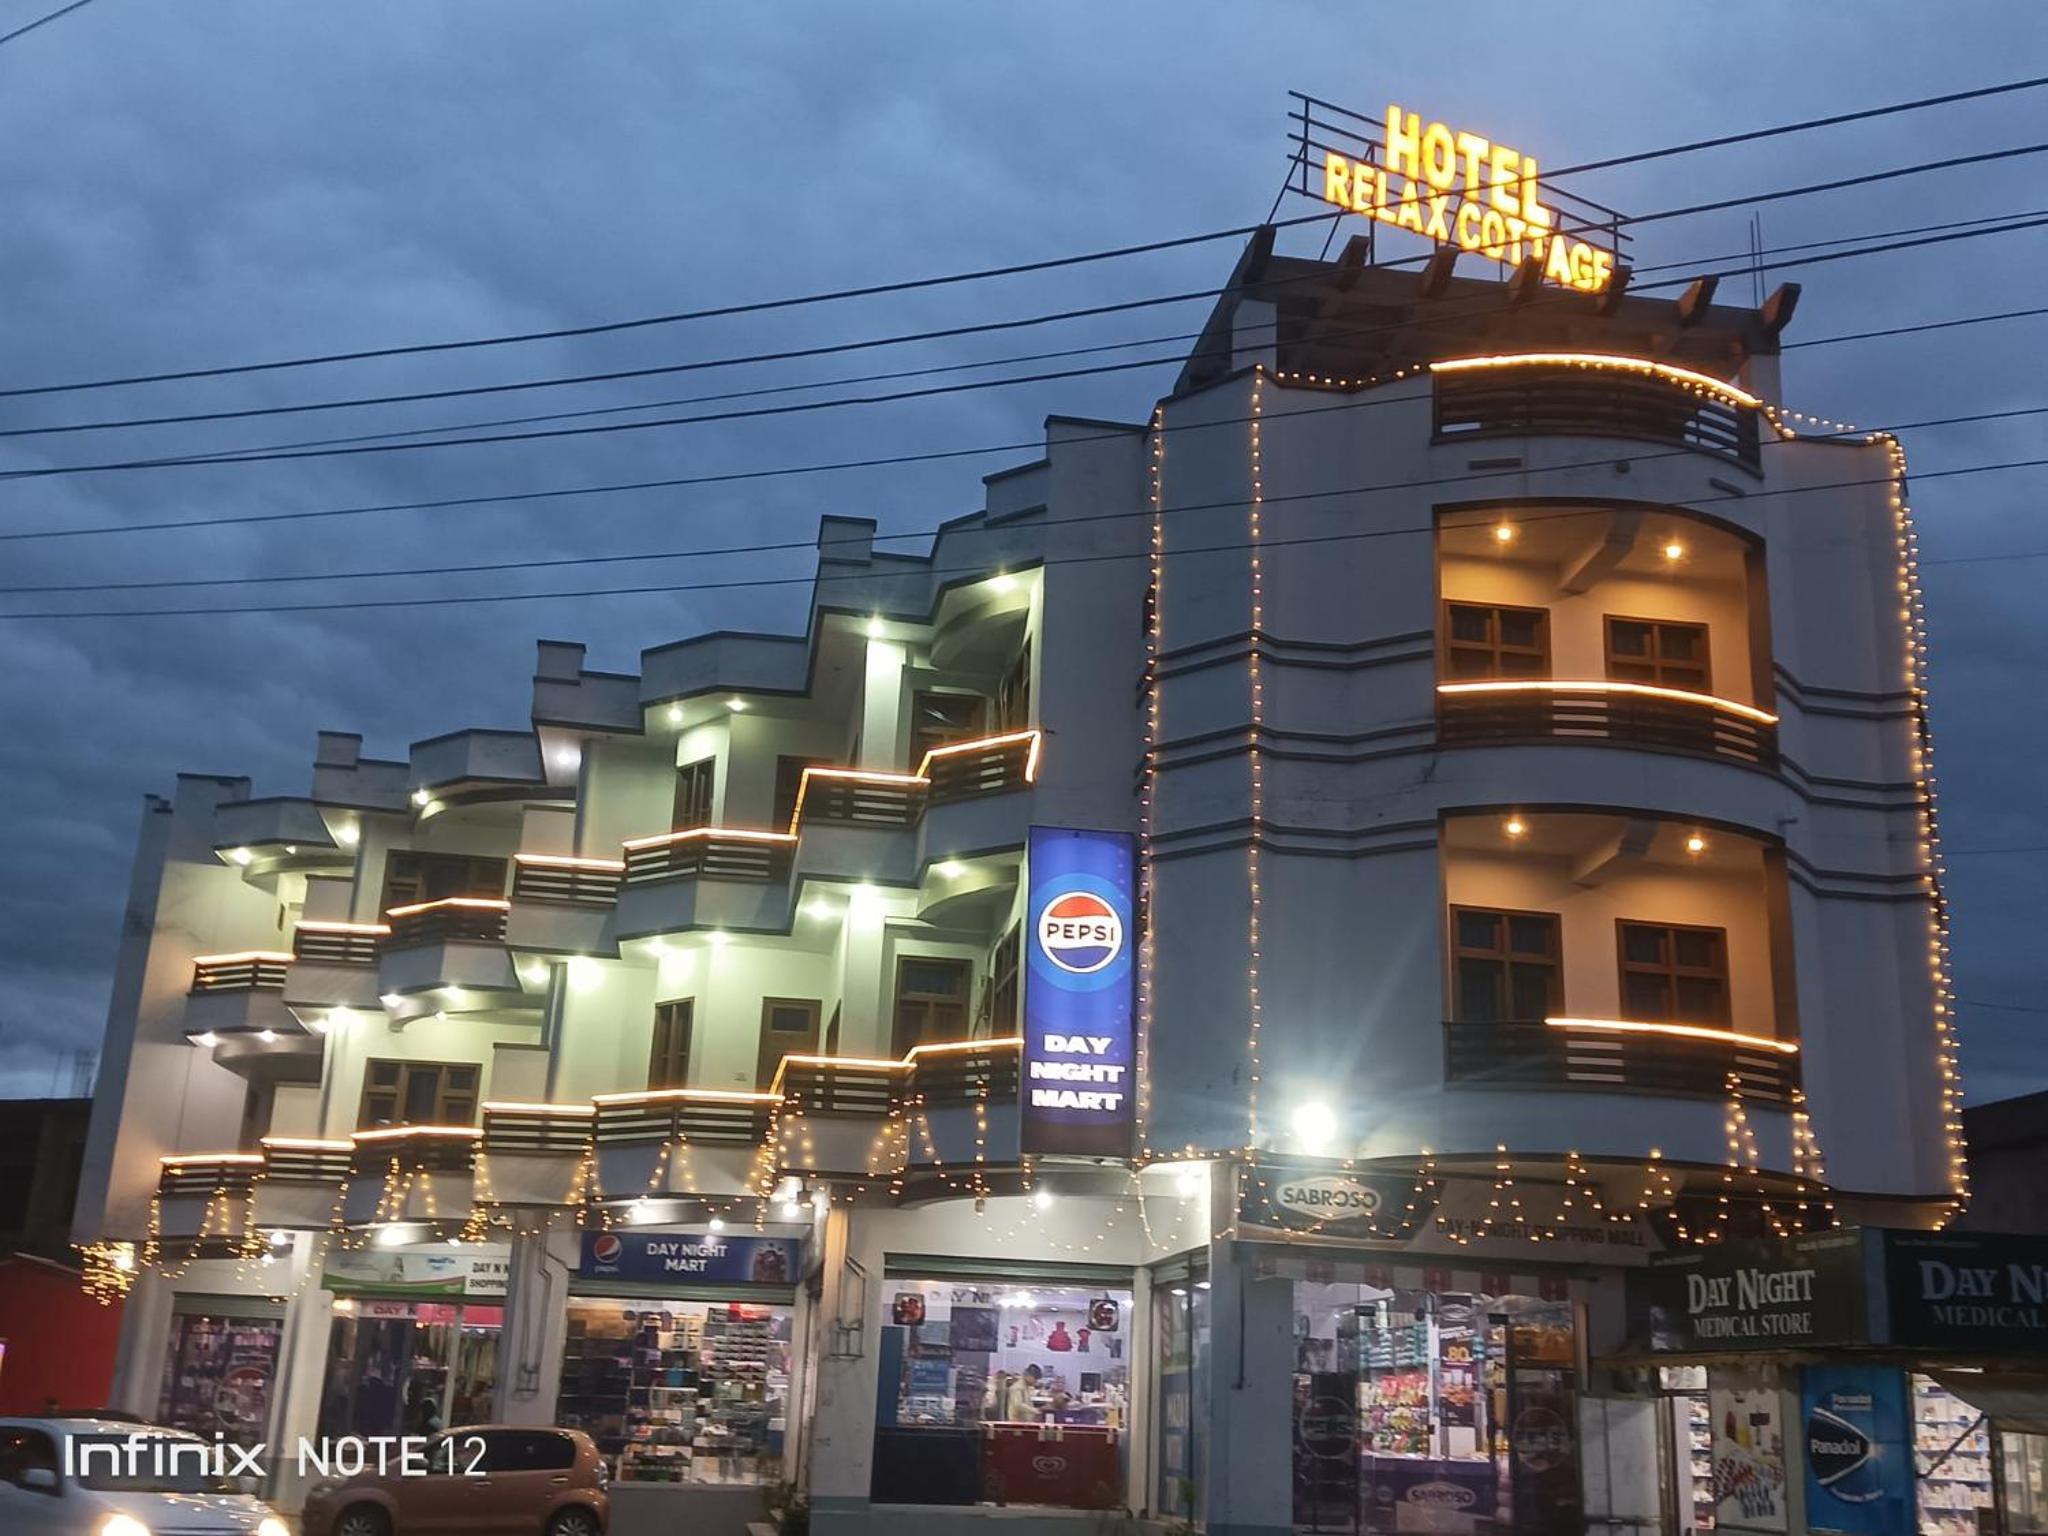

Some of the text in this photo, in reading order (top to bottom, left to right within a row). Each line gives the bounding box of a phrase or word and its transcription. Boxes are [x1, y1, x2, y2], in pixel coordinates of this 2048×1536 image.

[1385, 104, 1551, 225] HOTEL
[1325, 150, 1450, 242] RELAX
[1047, 922, 1116, 942] PEPSI
[1043, 1034, 1112, 1055] DAY
[1029, 1061, 1126, 1084] NIGHT
[1031, 1088, 1124, 1111] MART
[1283, 1186, 1378, 1209] SABROSO
[647, 1242, 728, 1257] DAY NIGHT
[664, 1259, 708, 1273] MART
[1686, 1268, 1816, 1314] DAY NIGHT
[1919, 1260, 1998, 1300] DAY
[1693, 1312, 1814, 1338] MEDICAL STORE
[1932, 1304, 2048, 1329] MEDICAL
[1810, 1438, 1861, 1455] Panadol
